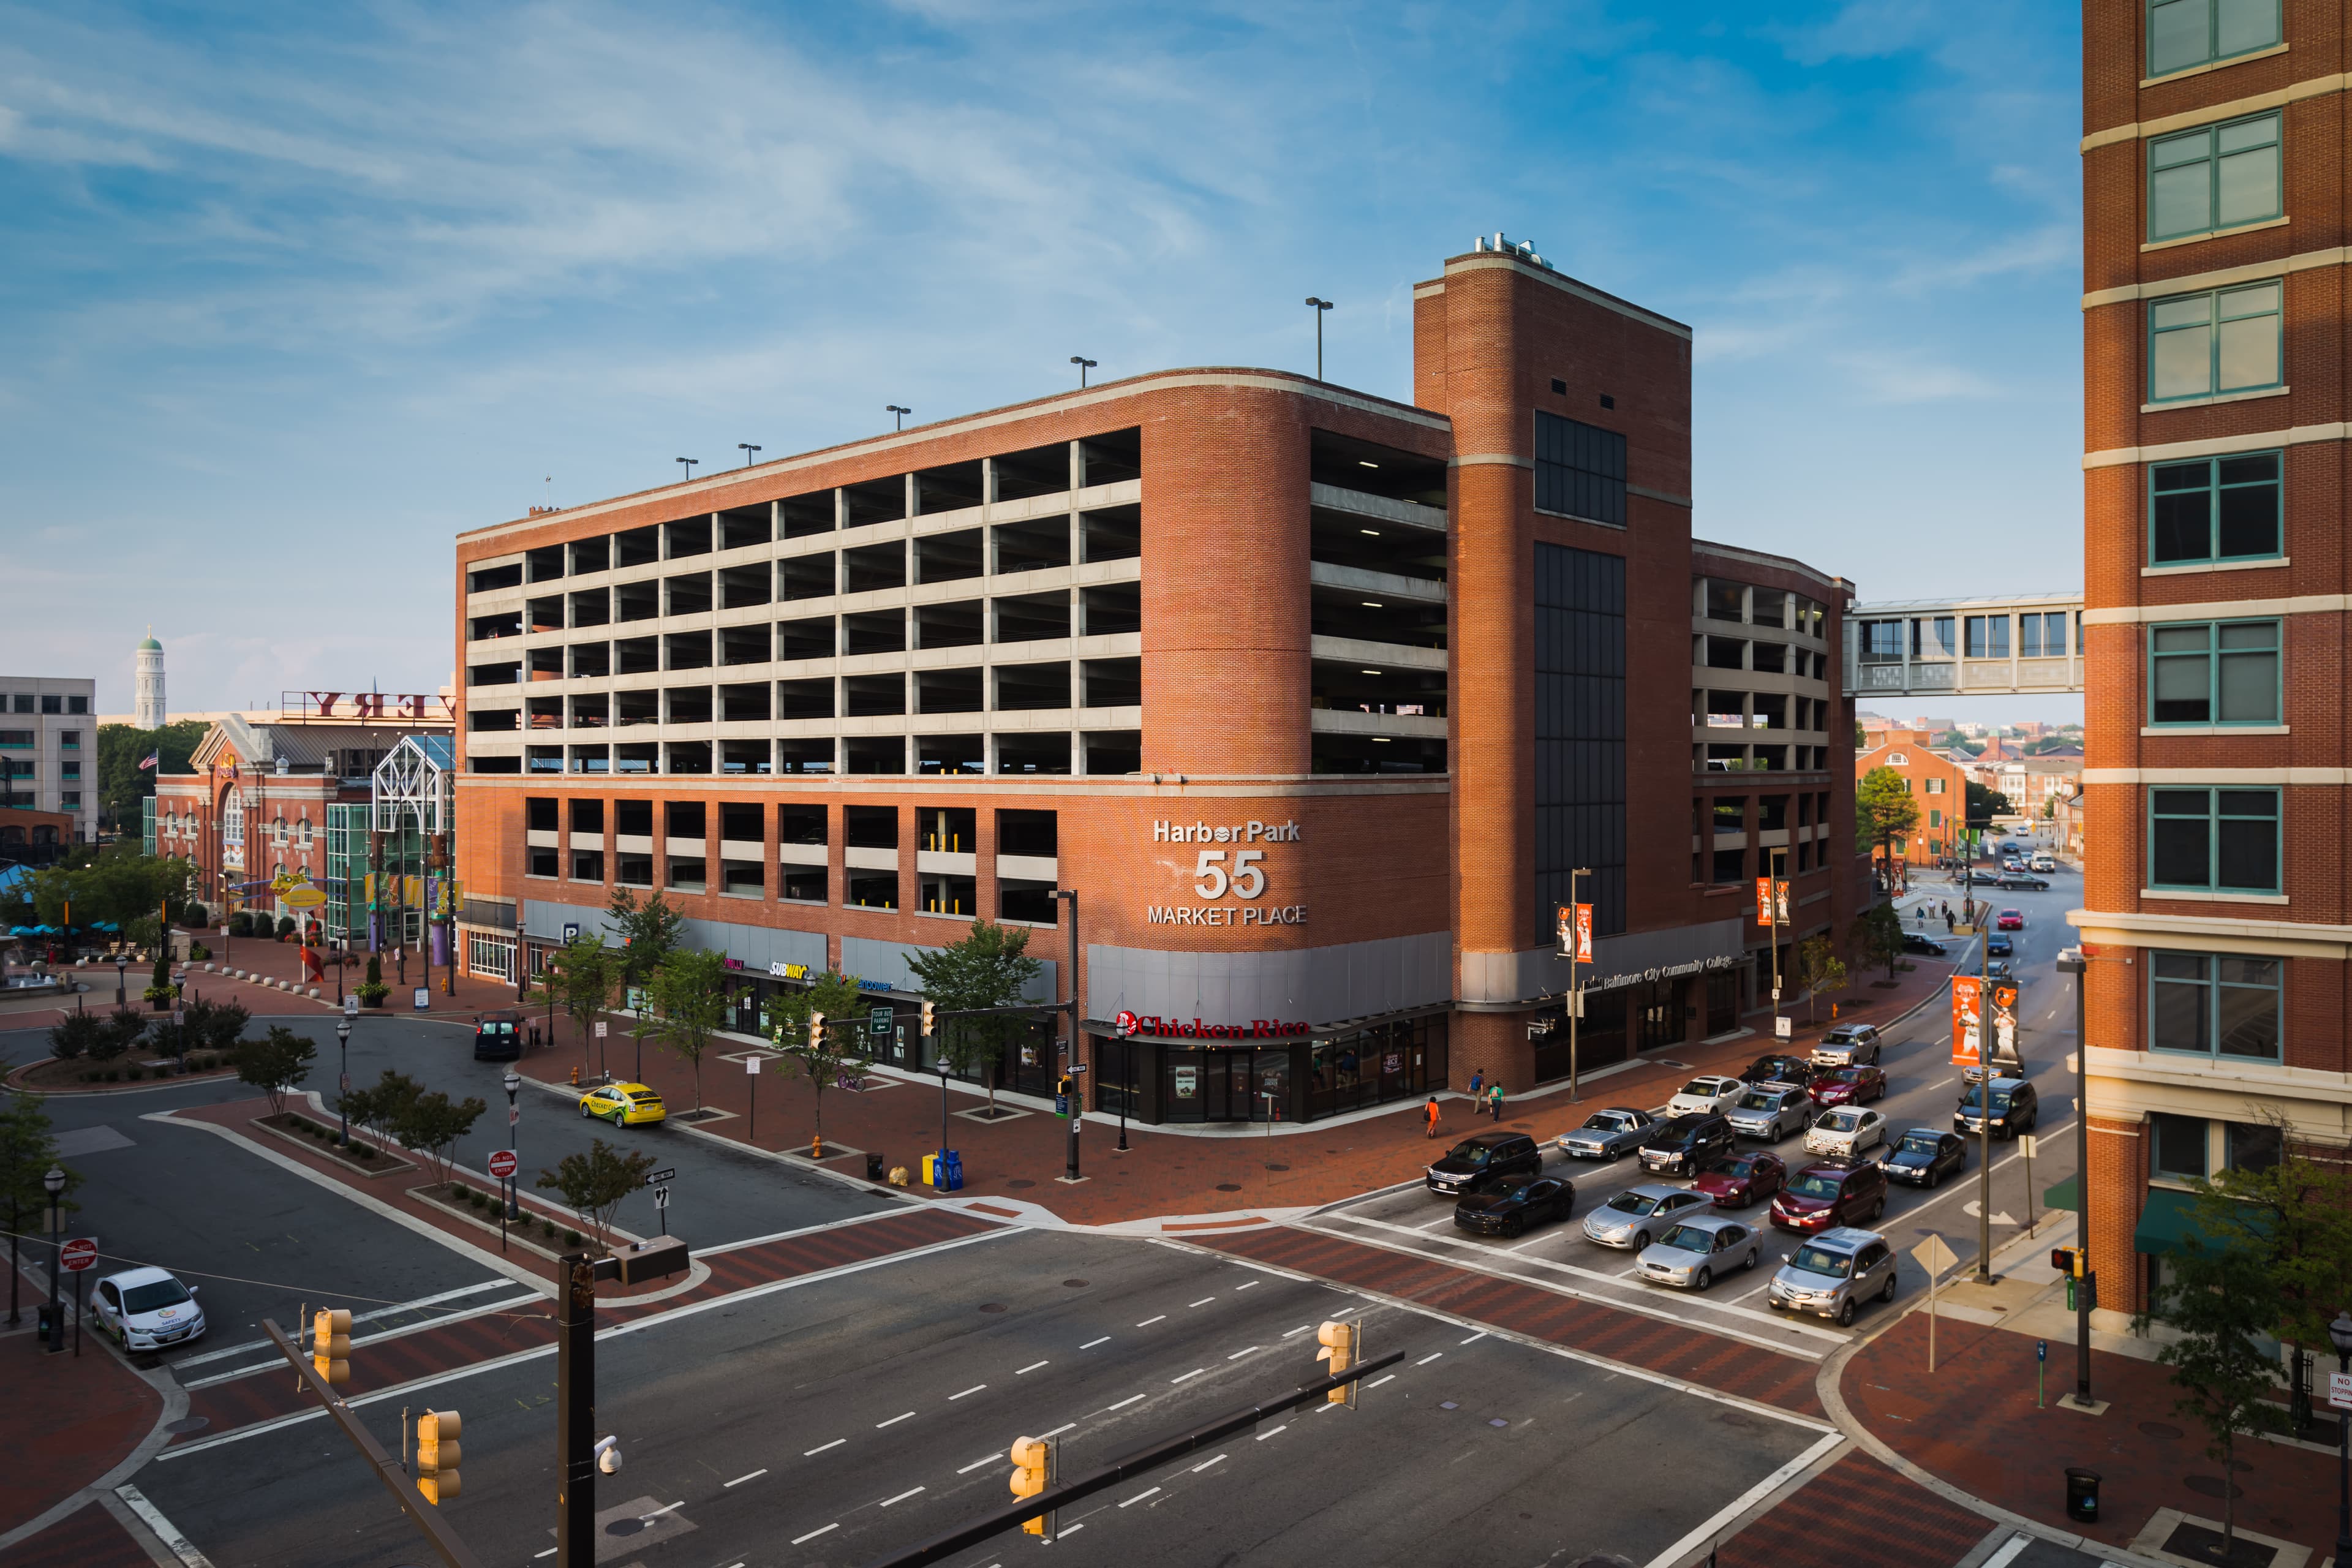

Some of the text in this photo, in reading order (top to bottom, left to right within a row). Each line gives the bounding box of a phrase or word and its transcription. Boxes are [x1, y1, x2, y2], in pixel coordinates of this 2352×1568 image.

[1154, 820, 1300, 842] Harbor Park
[1194, 850, 1265, 900] 55
[1148, 905, 1307, 925] MARKET PLACE
[769, 961, 807, 979] SUBWAY
[1604, 956, 1732, 990] Baltimore City Community College
[858, 979, 890, 992] anpower
[1137, 1016, 1310, 1039] Chicken Rico
[591, 1099, 608, 1109] Checker
[161, 1317, 181, 1326] SAFETY
[2337, 1378, 2350, 1386] NO
[2331, 1387, 2352, 1396] STOPPIN
